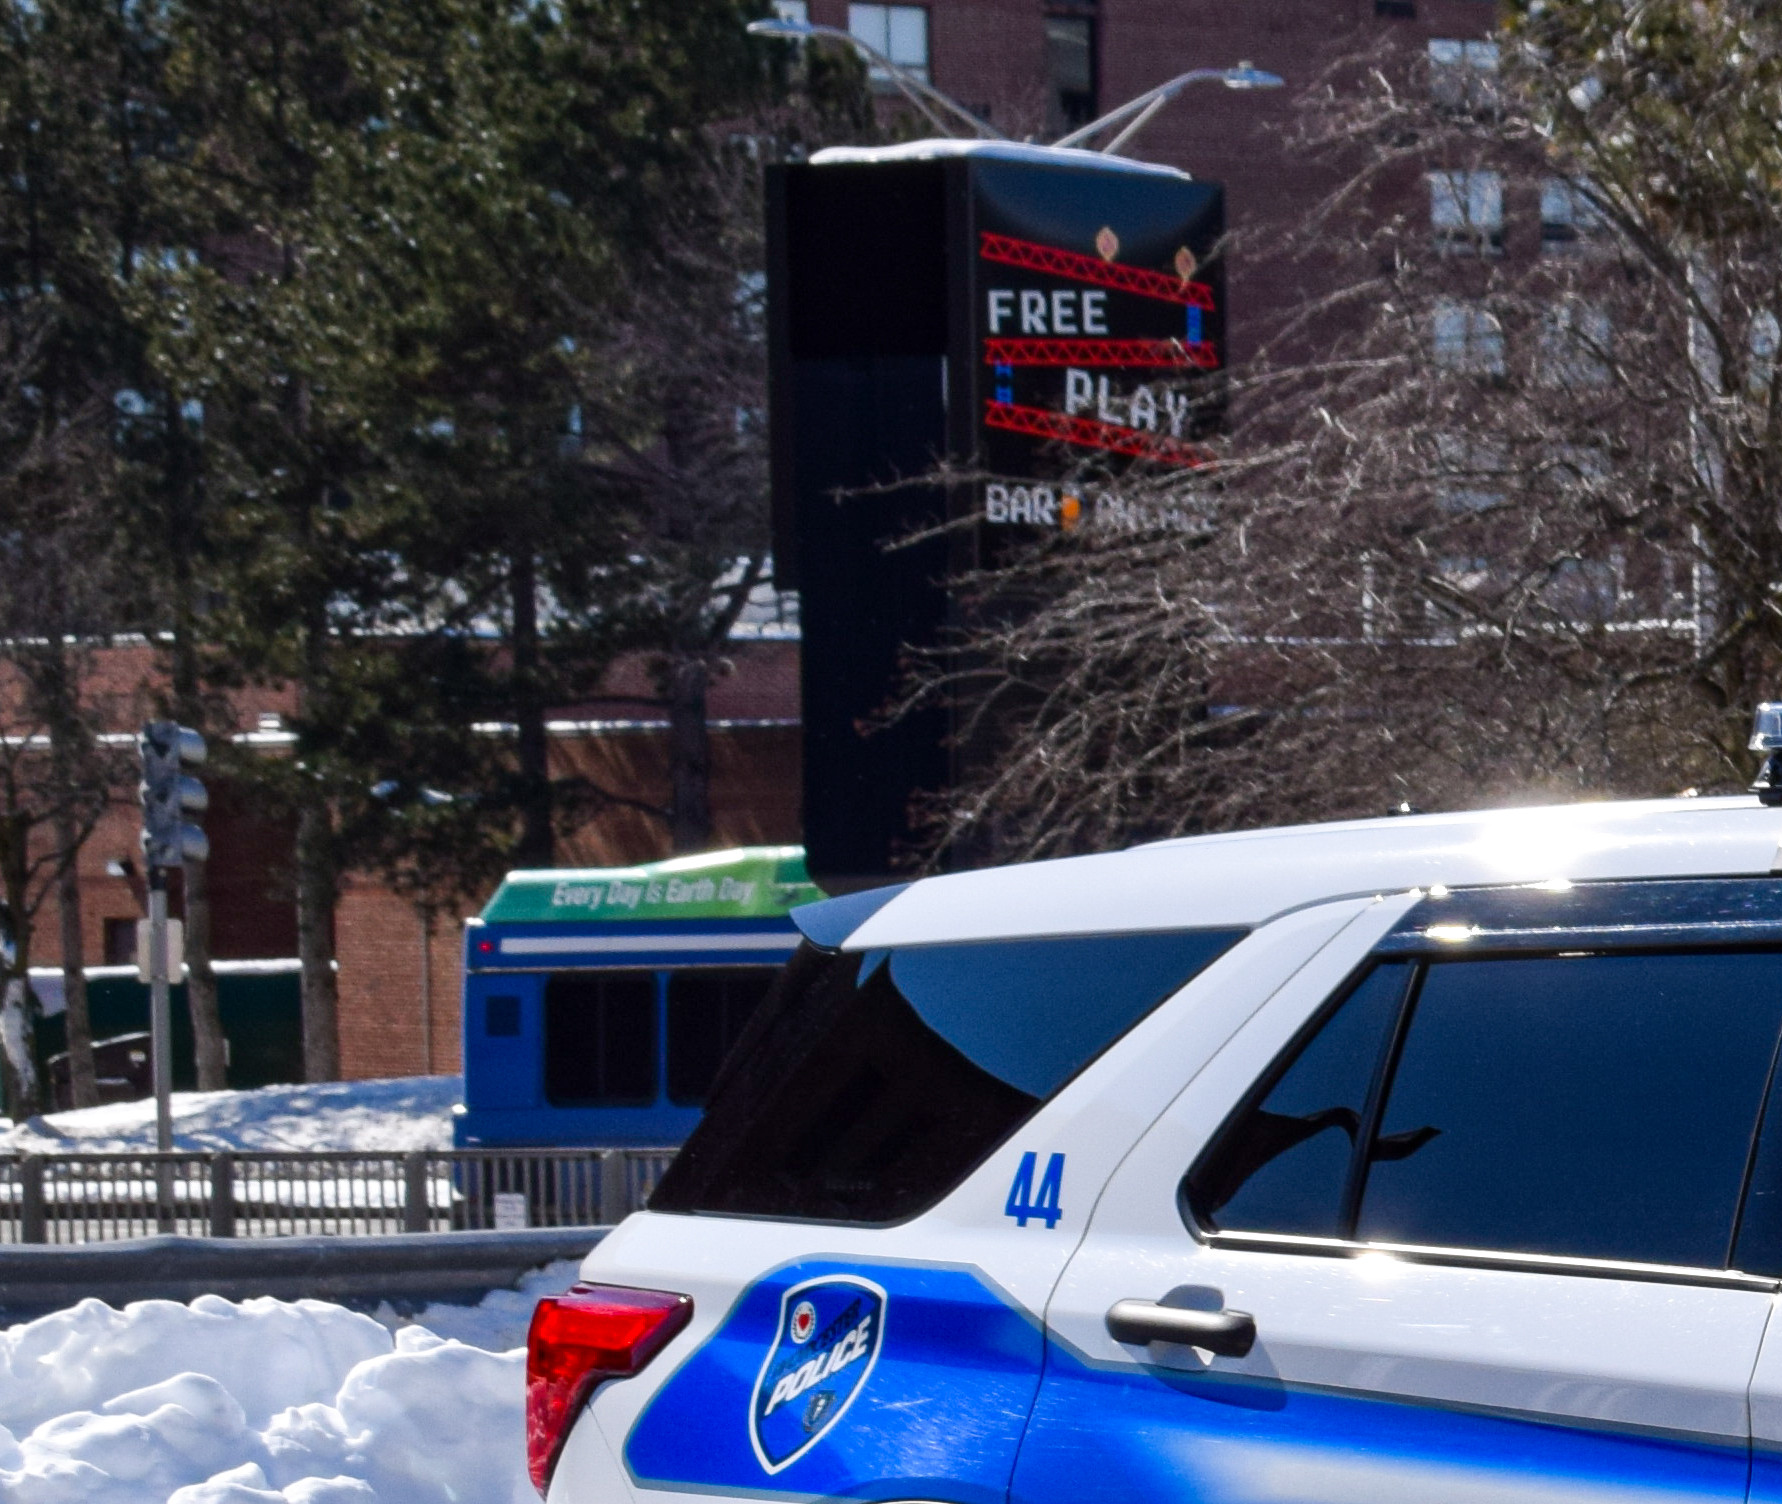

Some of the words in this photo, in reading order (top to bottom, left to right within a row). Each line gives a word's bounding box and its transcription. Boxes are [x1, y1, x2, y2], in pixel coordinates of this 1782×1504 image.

[987, 289, 1109, 335] FREE
[1065, 366, 1188, 438] PLAY
[985, 483, 1057, 525] BAR
[552, 879, 603, 910] Every
[606, 879, 643, 909] Day
[665, 875, 715, 904] Earth
[718, 875, 755, 907] Day
[1004, 1151, 1066, 1229] 44
[764, 1314, 872, 1416] POLICE
